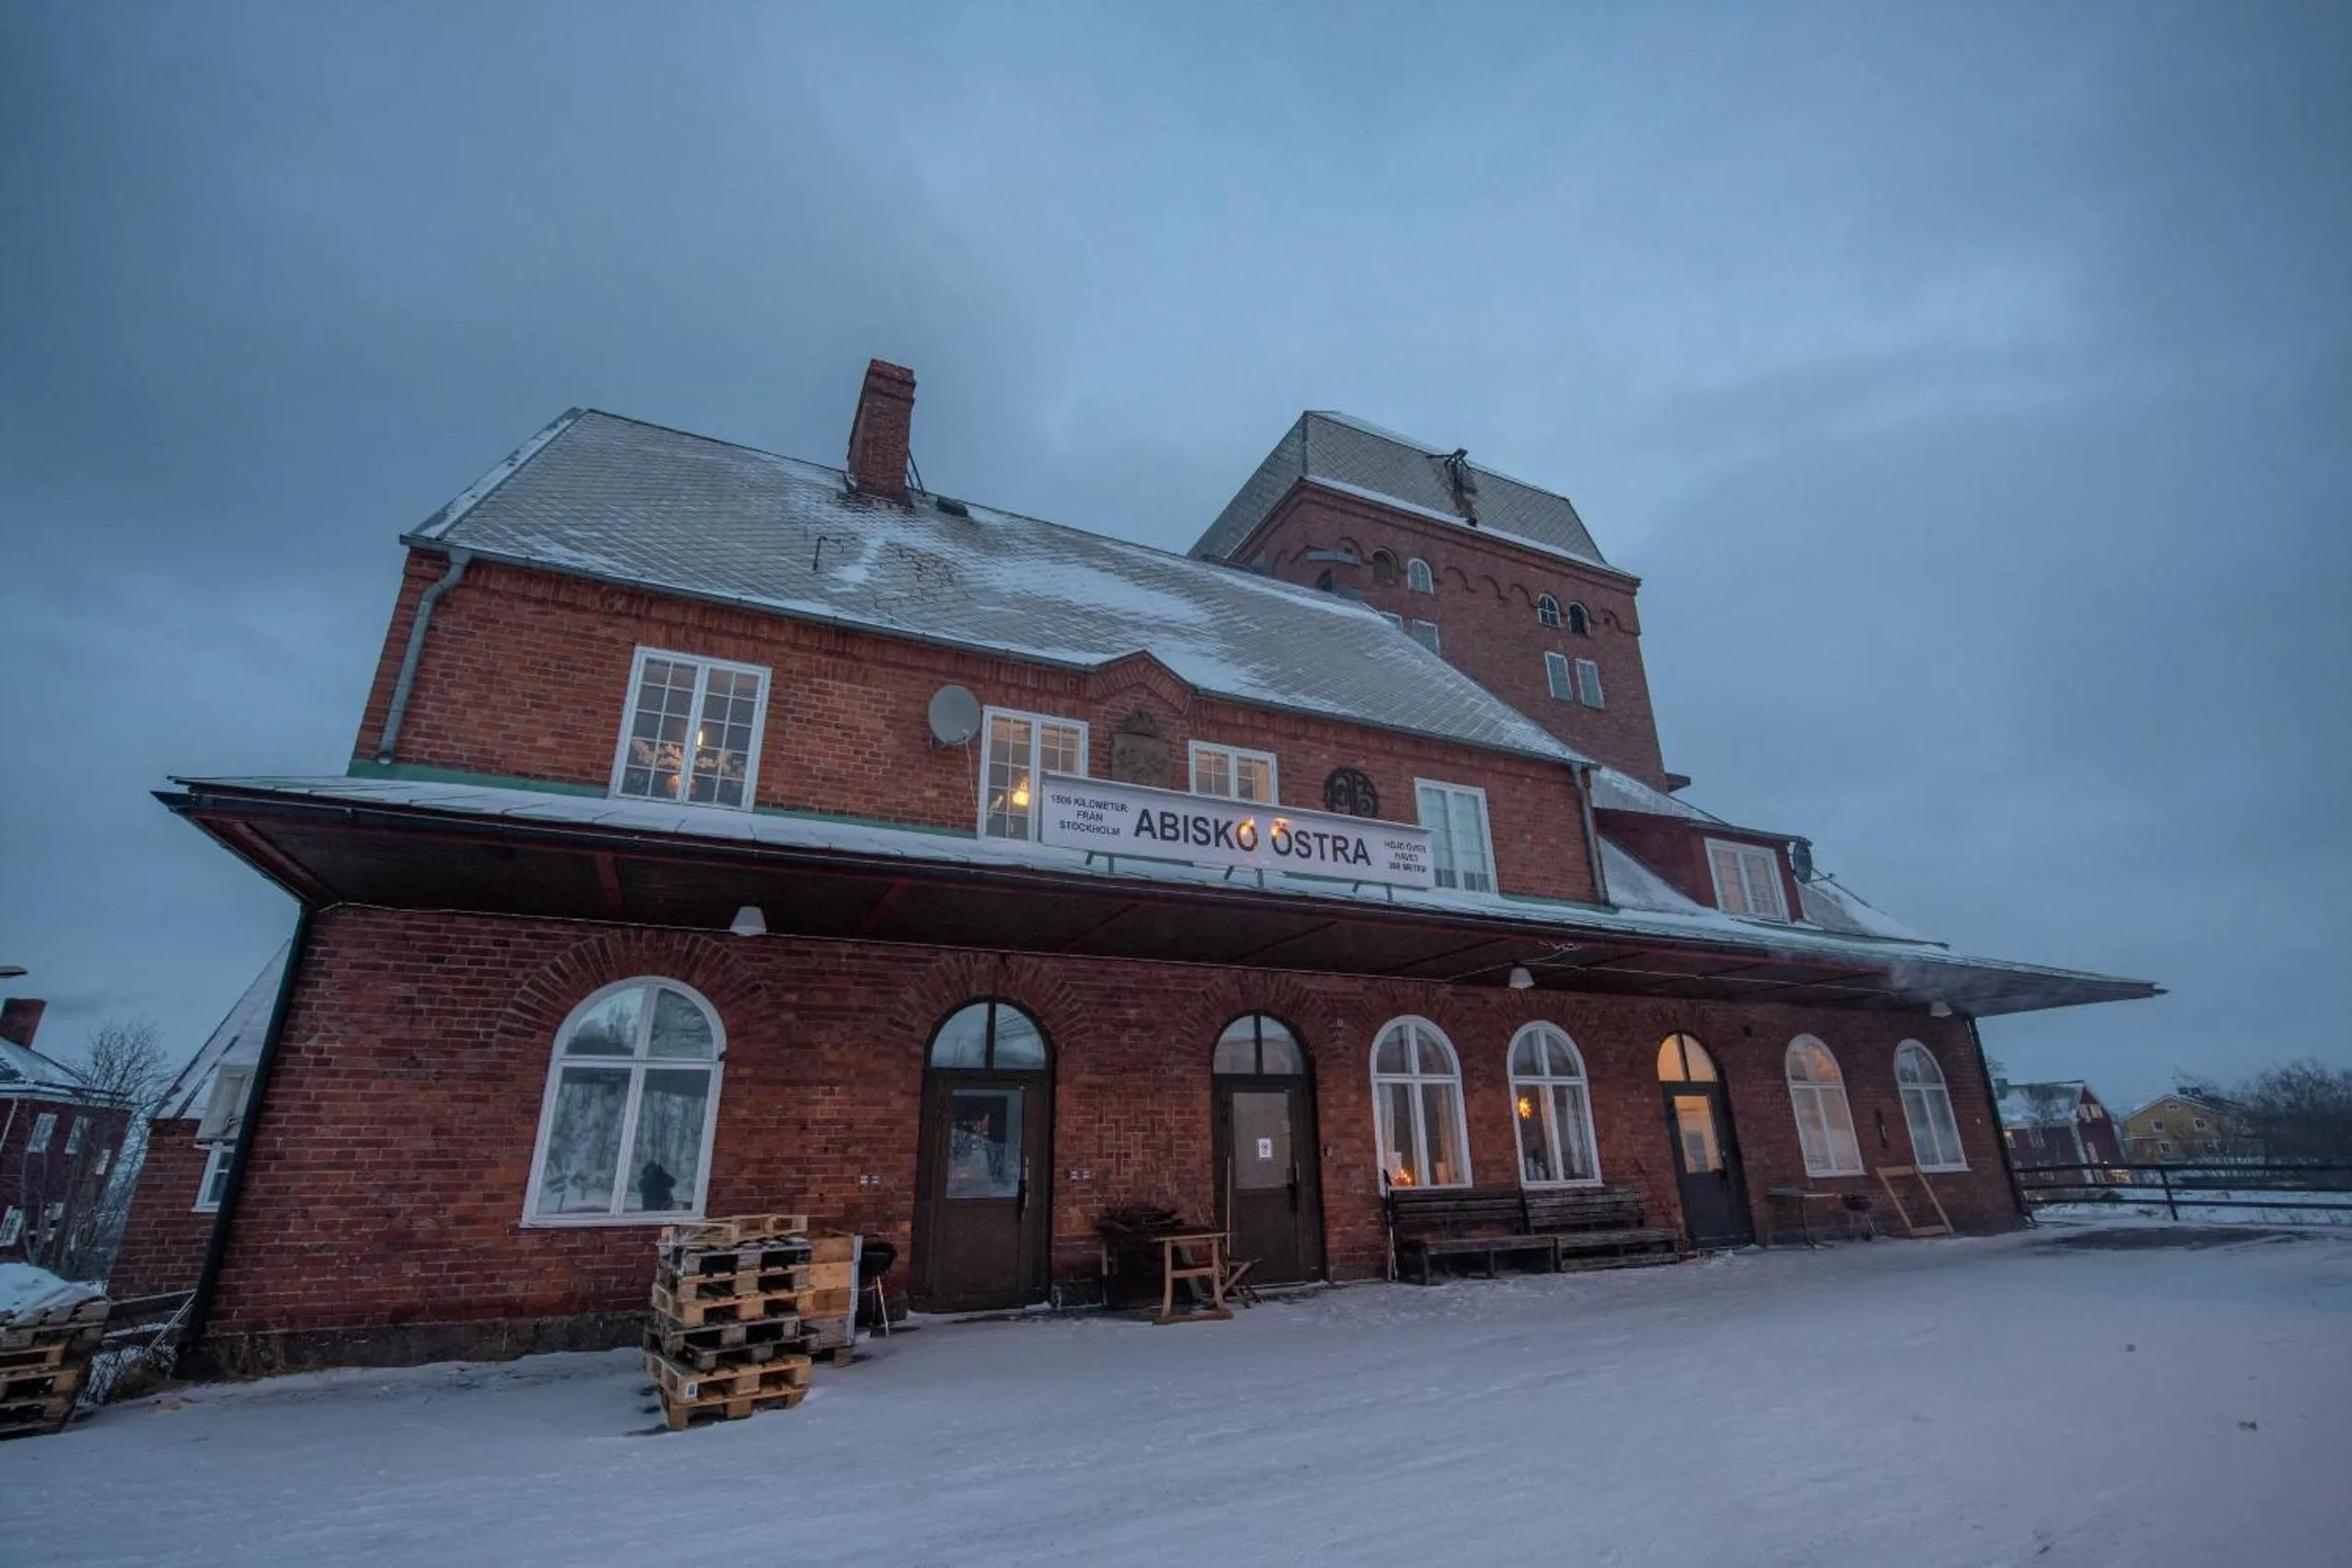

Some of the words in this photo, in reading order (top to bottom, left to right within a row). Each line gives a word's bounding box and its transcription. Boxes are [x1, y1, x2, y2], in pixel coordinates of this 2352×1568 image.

[1073, 796, 1129, 813] KILOMETER
[1076, 808, 1103, 822] FRÅN
[1059, 820, 1121, 837] STOCKHOLM
[1134, 808, 1258, 853] ABISKO
[1271, 820, 1372, 867] ÖSTRA
